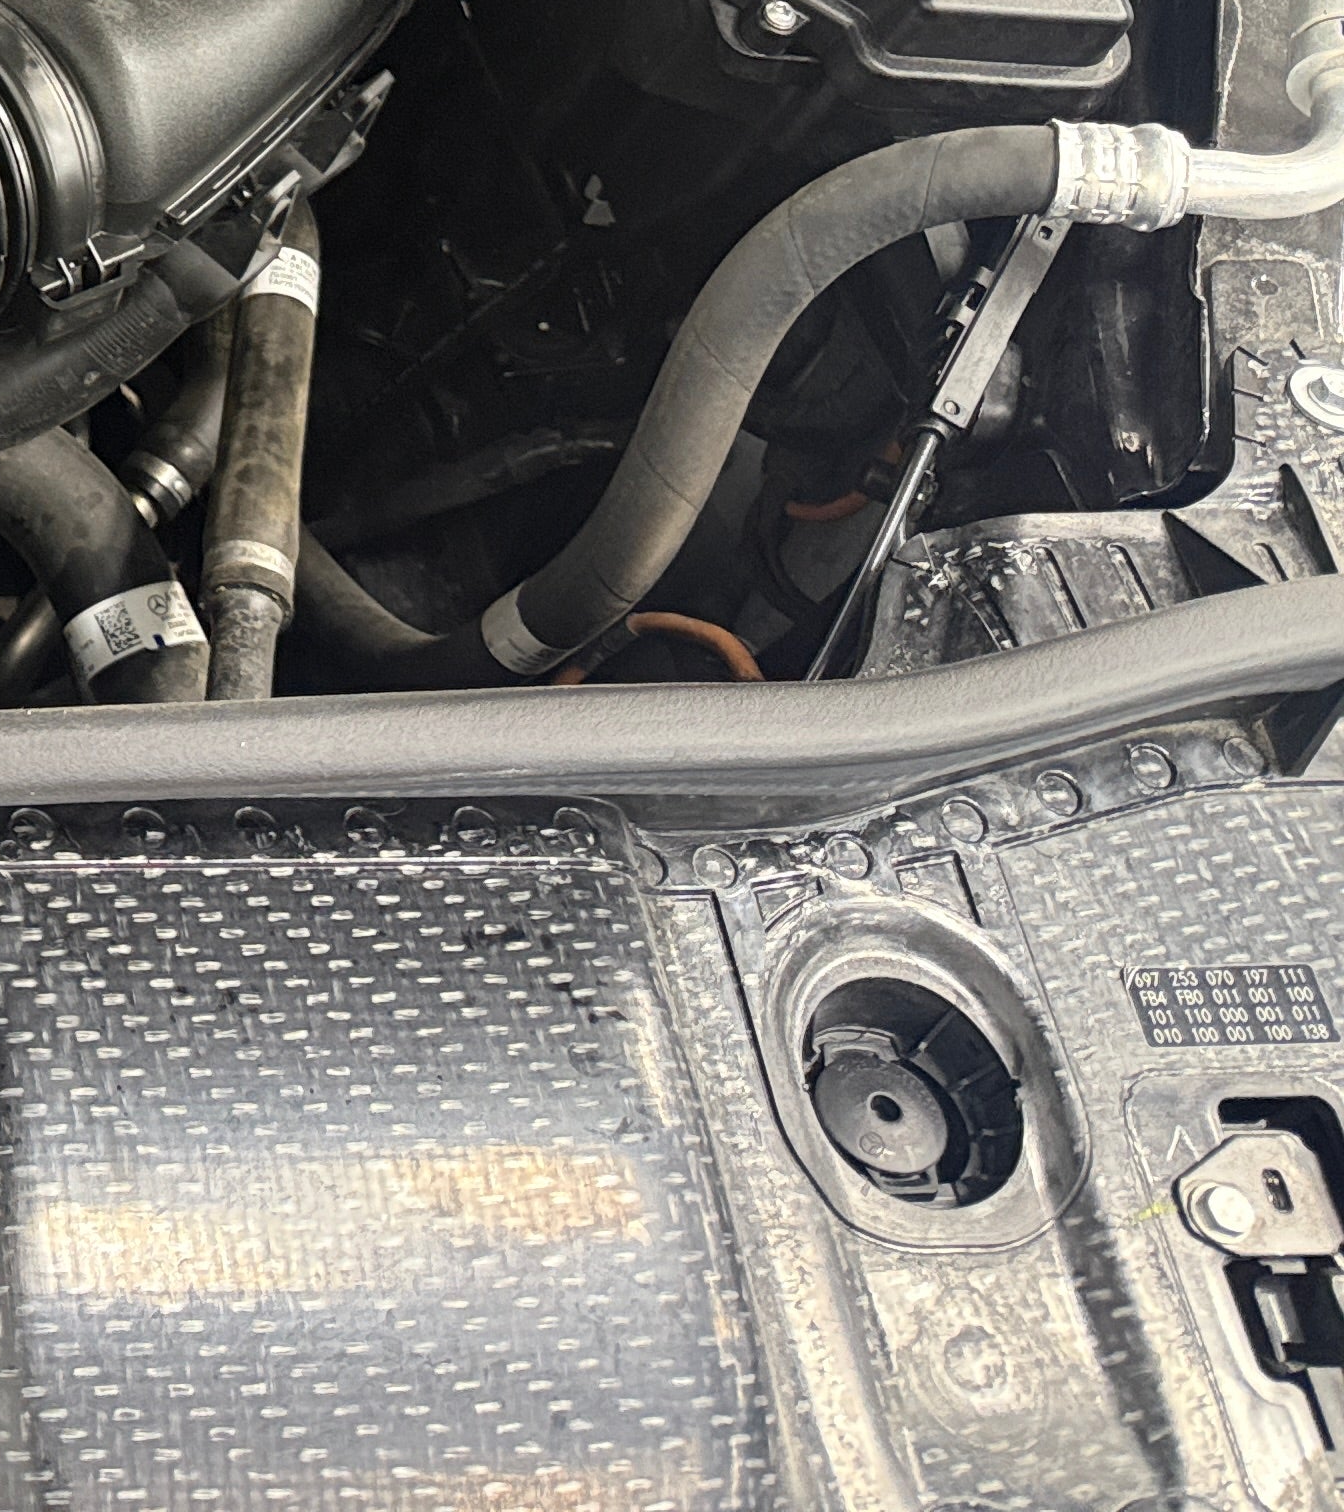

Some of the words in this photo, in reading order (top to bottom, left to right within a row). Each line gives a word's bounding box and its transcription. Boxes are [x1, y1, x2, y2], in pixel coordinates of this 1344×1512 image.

[1135, 972, 1159, 987] 697
[1169, 971, 1198, 987] 253
[1206, 970, 1234, 985] 070
[1243, 969, 1268, 985] 197
[1279, 968, 1306, 983] 111
[1139, 991, 1167, 1006] FB4
[1176, 990, 1204, 1005] FB0
[1212, 989, 1241, 1004] 011
[1249, 987, 1277, 1003] 001
[1287, 986, 1314, 1002] 100
[1148, 1010, 1175, 1025] 101
[1185, 1009, 1212, 1024] 110
[1220, 1008, 1249, 1023] 000
[1256, 1006, 1284, 1022] 001
[1292, 1005, 1321, 1021] 011
[1153, 1028, 1182, 1044] 010
[1192, 1027, 1219, 1042] 100
[1226, 1026, 1255, 1042] 001
[1264, 1025, 1292, 1041] 100
[1301, 1024, 1329, 1040] 138
